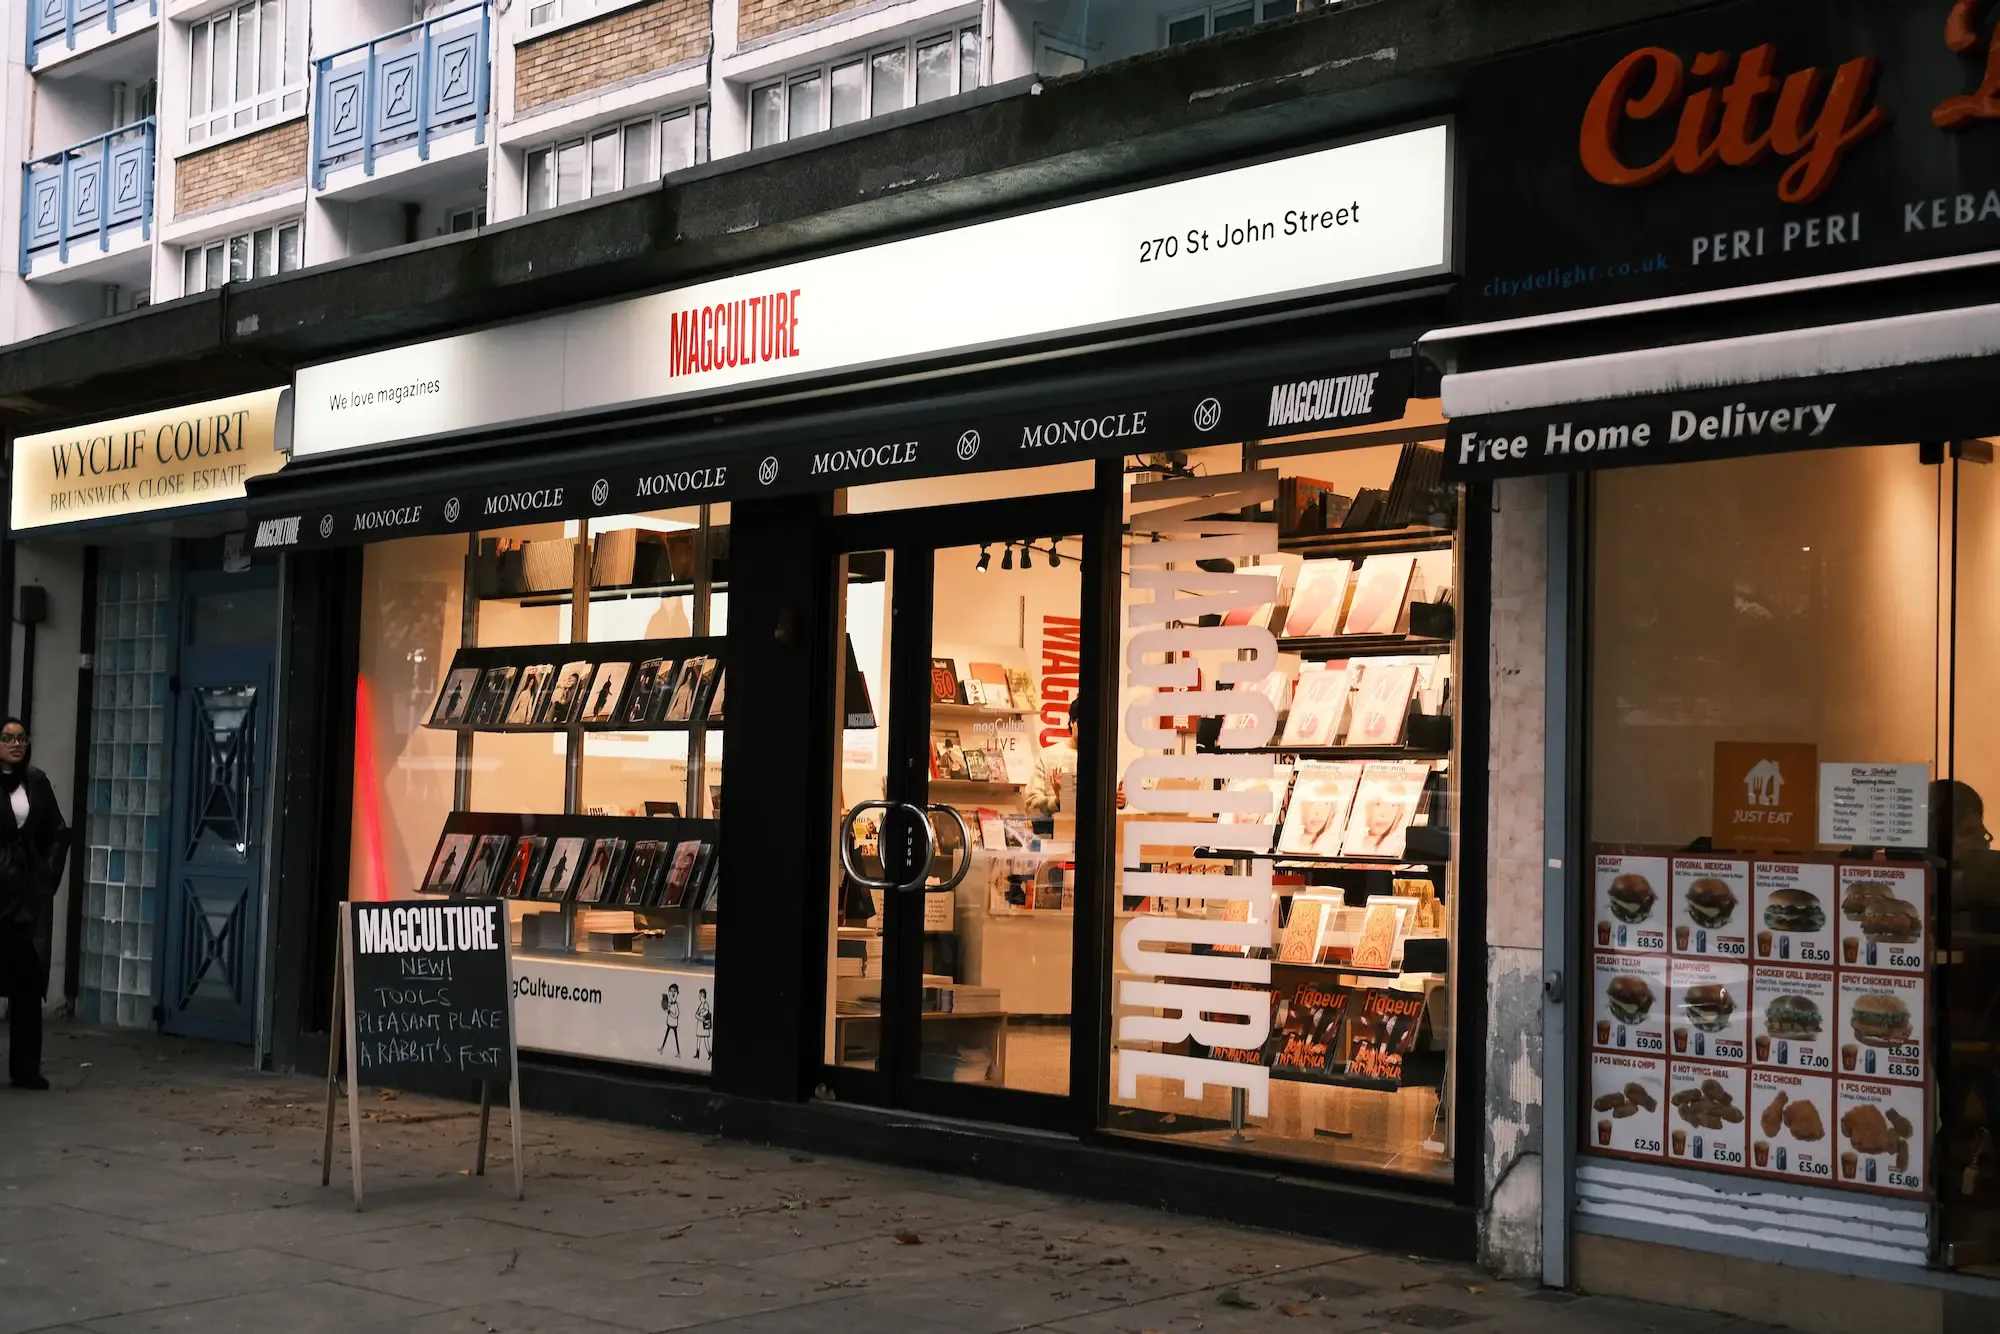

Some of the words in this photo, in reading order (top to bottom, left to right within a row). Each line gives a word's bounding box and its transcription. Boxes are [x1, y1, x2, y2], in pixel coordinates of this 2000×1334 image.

[1579, 43, 1886, 203] City
[1139, 235, 1179, 263] 270
[1186, 229, 1209, 254] St
[1217, 218, 1275, 248] John
[1283, 200, 1360, 236] Street
[1692, 227, 1764, 266] PERI
[1783, 212, 1860, 252] PERI
[1483, 253, 1669, 297] citydelight.co.uk
[670, 289, 800, 378] MAGCULTURE
[329, 393, 348, 411] We
[350, 391, 374, 408] love
[377, 378, 440, 404] magazines
[1458, 431, 1529, 465] Free
[1544, 421, 1651, 455] Home
[1668, 402, 1838, 444] Delivery
[51, 429, 146, 481] WYCLIF
[156, 410, 250, 464] COURT
[254, 516, 301, 548] MAGCULTURE
[353, 505, 422, 531] MONOCLE
[484, 487, 564, 515] MONOCLE
[636, 466, 727, 497] MONOCLE
[811, 441, 919, 475] MONOCLE
[1020, 411, 1148, 449] MONOCLE
[1268, 371, 1379, 427] MAGCULTURE
[50, 482, 132, 512] BRUNSWICK
[138, 473, 185, 499] CLOSE
[193, 463, 247, 491] ESTATE
[973, 717, 1028, 735] magCultur
[986, 738, 1016, 751] LIVE
[1852, 778, 1877, 786] Opening
[1118, 468, 1279, 1118] MAGCULTURE
[1733, 809, 1765, 824] JUST
[1767, 811, 1793, 824] EAT
[1833, 825, 1856, 833] Saturday
[1597, 857, 1622, 866] DELIGHT
[1675, 860, 1702, 869] ORIGINAL
[1704, 862, 1732, 871] MEXICAN
[1756, 864, 1773, 872] HALF
[1774, 865, 1799, 874] CHEESE
[1842, 868, 1848, 876] 2
[1848, 869, 1871, 878] STRIPS
[1873, 870, 1905, 879] BURGERS
[358, 905, 498, 954] MAGCULTURE
[1637, 937, 1664, 949] £8.50
[1717, 942, 1745, 954] £9.00
[1596, 956, 1620, 965] DELIGHT
[1801, 948, 1830, 960] £8.50
[1890, 955, 1921, 967] £6.00
[401, 956, 453, 981] NEW!
[1756, 968, 1784, 977] CHICKEN
[1785, 970, 1805, 979] GRILL
[1805, 972, 1832, 982] BURGER
[1841, 976, 1862, 985] SPICY
[1862, 977, 1893, 987] CHICKEN
[1893, 979, 1917, 989] FILLET
[374, 987, 452, 1007] TOOLS
[356, 1010, 441, 1034] PLEASANT
[449, 1008, 502, 1030] PLACE
[1636, 1037, 1662, 1050] £9.00
[360, 1041, 373, 1067] A
[377, 1036, 452, 1066] RABBIT'S
[1716, 1046, 1743, 1058] £9.00
[1888, 1045, 1919, 1058] £6.30
[1594, 1056, 1598, 1064] 3
[1599, 1057, 1611, 1065] PCS
[1612, 1058, 1631, 1067] WINGS
[1632, 1060, 1637, 1068] &
[1637, 1060, 1656, 1069] CHIPS
[1800, 1055, 1829, 1067] £7.00
[1673, 1064, 1677, 1072] 6
[1678, 1065, 1691, 1074] HOT
[1691, 1067, 1712, 1076] WINGS
[1712, 1069, 1729, 1079] MEAL
[1889, 1064, 1919, 1077] £8.50
[1753, 1073, 1758, 1081] 2
[1759, 1074, 1773, 1083] PCS
[1773, 1076, 1802, 1086] CHICKEN
[1846, 1084, 1860, 1093] PCS
[1861, 1085, 1892, 1096] CHICKEN
[1634, 1138, 1660, 1151] £2.50
[1713, 1150, 1741, 1162] £5.00
[1799, 1161, 1828, 1175] £5.00
